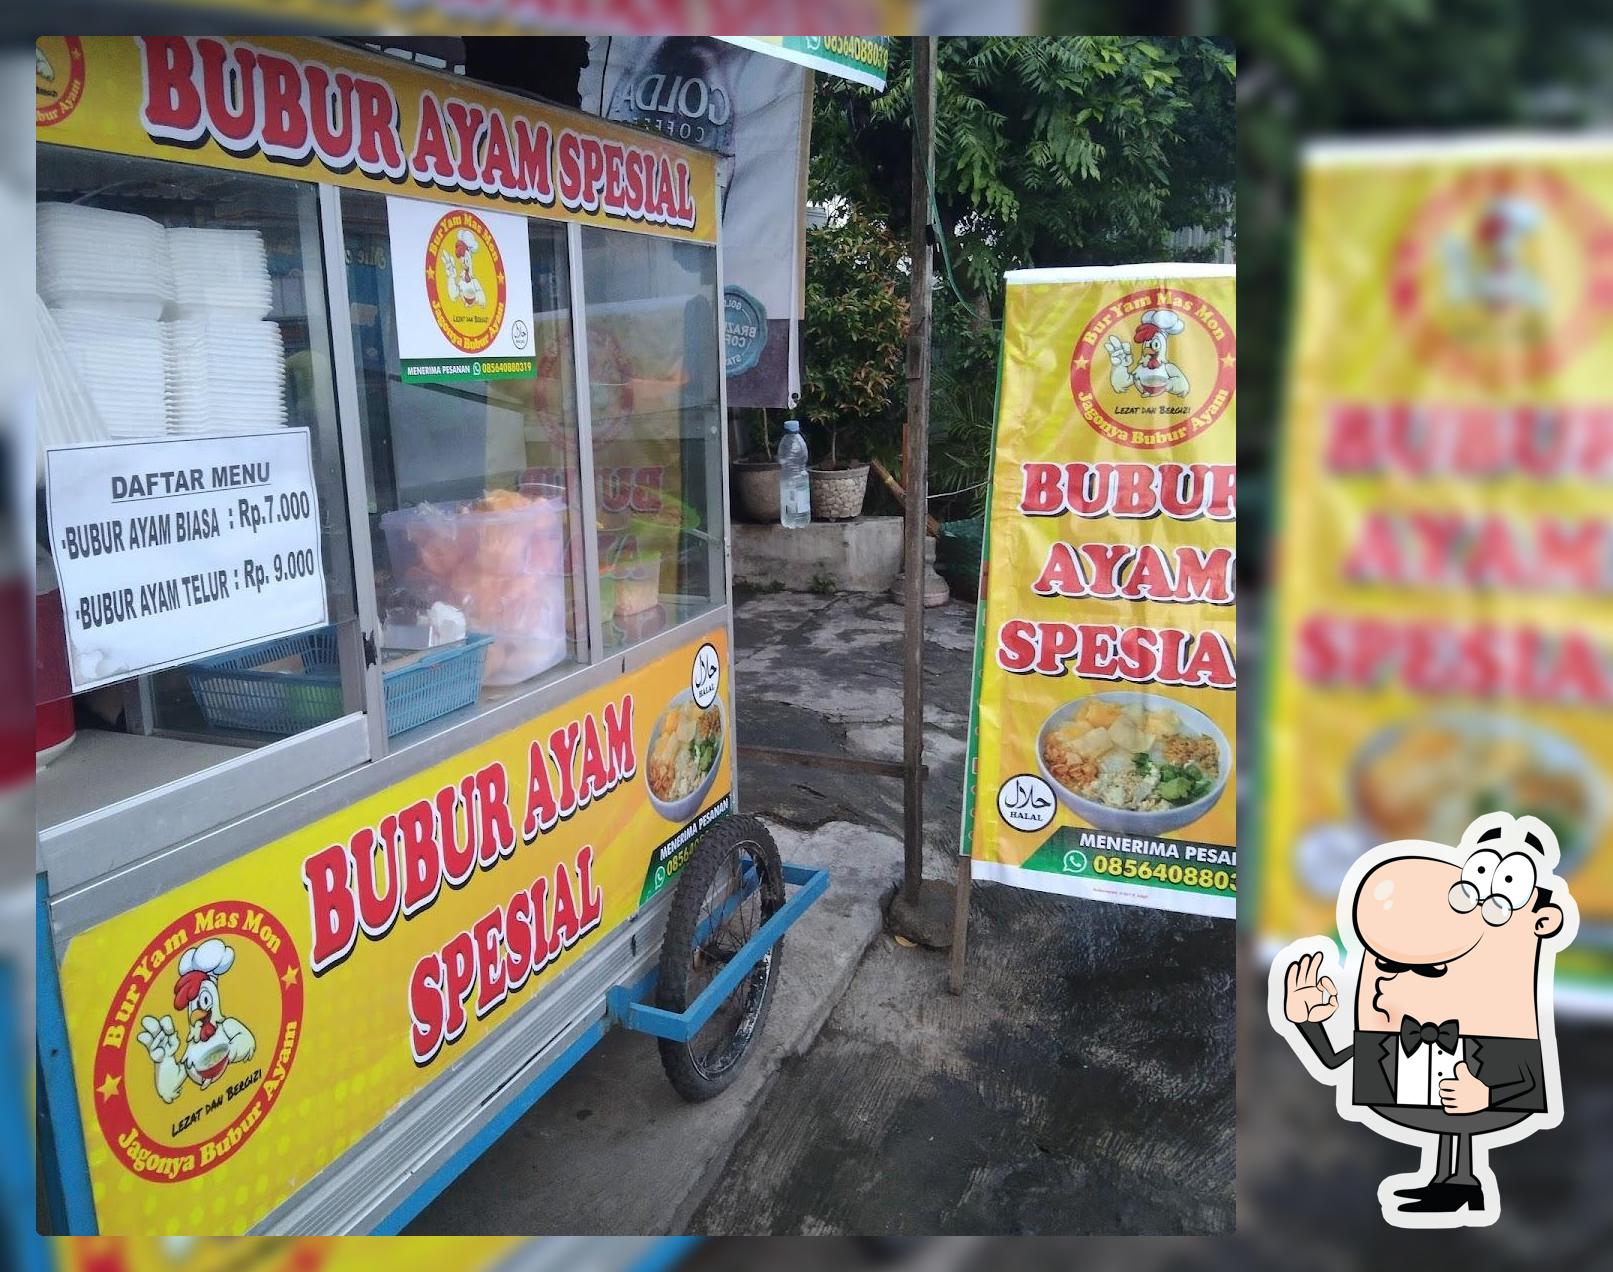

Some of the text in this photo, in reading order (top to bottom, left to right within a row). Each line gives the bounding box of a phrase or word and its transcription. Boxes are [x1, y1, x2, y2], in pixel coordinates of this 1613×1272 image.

[140, 36, 696, 232] BUBUR AYAM SPESIAL
[1082, 291, 1225, 346] Bur Yam Mas Mon
[407, 361, 532, 377] MENERIMA PESANAN 085640880319
[1078, 389, 1229, 445] Jagonya Bubur Ayam
[112, 462, 271, 499] DAFTAR MENU
[129, 514, 172, 551] AYAM
[176, 508, 220, 543] BIASA
[140, 578, 181, 616] AYAM
[182, 569, 230, 607] TELUR
[244, 559, 270, 593] Rp.
[274, 548, 315, 582] 9.000
[1030, 541, 1236, 604] AYAM
[302, 694, 637, 978] BUBUR AYAM
[660, 798, 729, 861] MENERIMA PESANAN
[1010, 811, 1043, 822] HALAL
[1079, 833, 1179, 859] MENERIMA
[103, 909, 281, 1048] Bur Yam Mas Mon
[408, 844, 603, 1068] SPESIAL
[118, 1021, 297, 1179] Jagonya Bubur Ayam
[171, 1069, 262, 1137] LEZAT DAN BERGIZI
